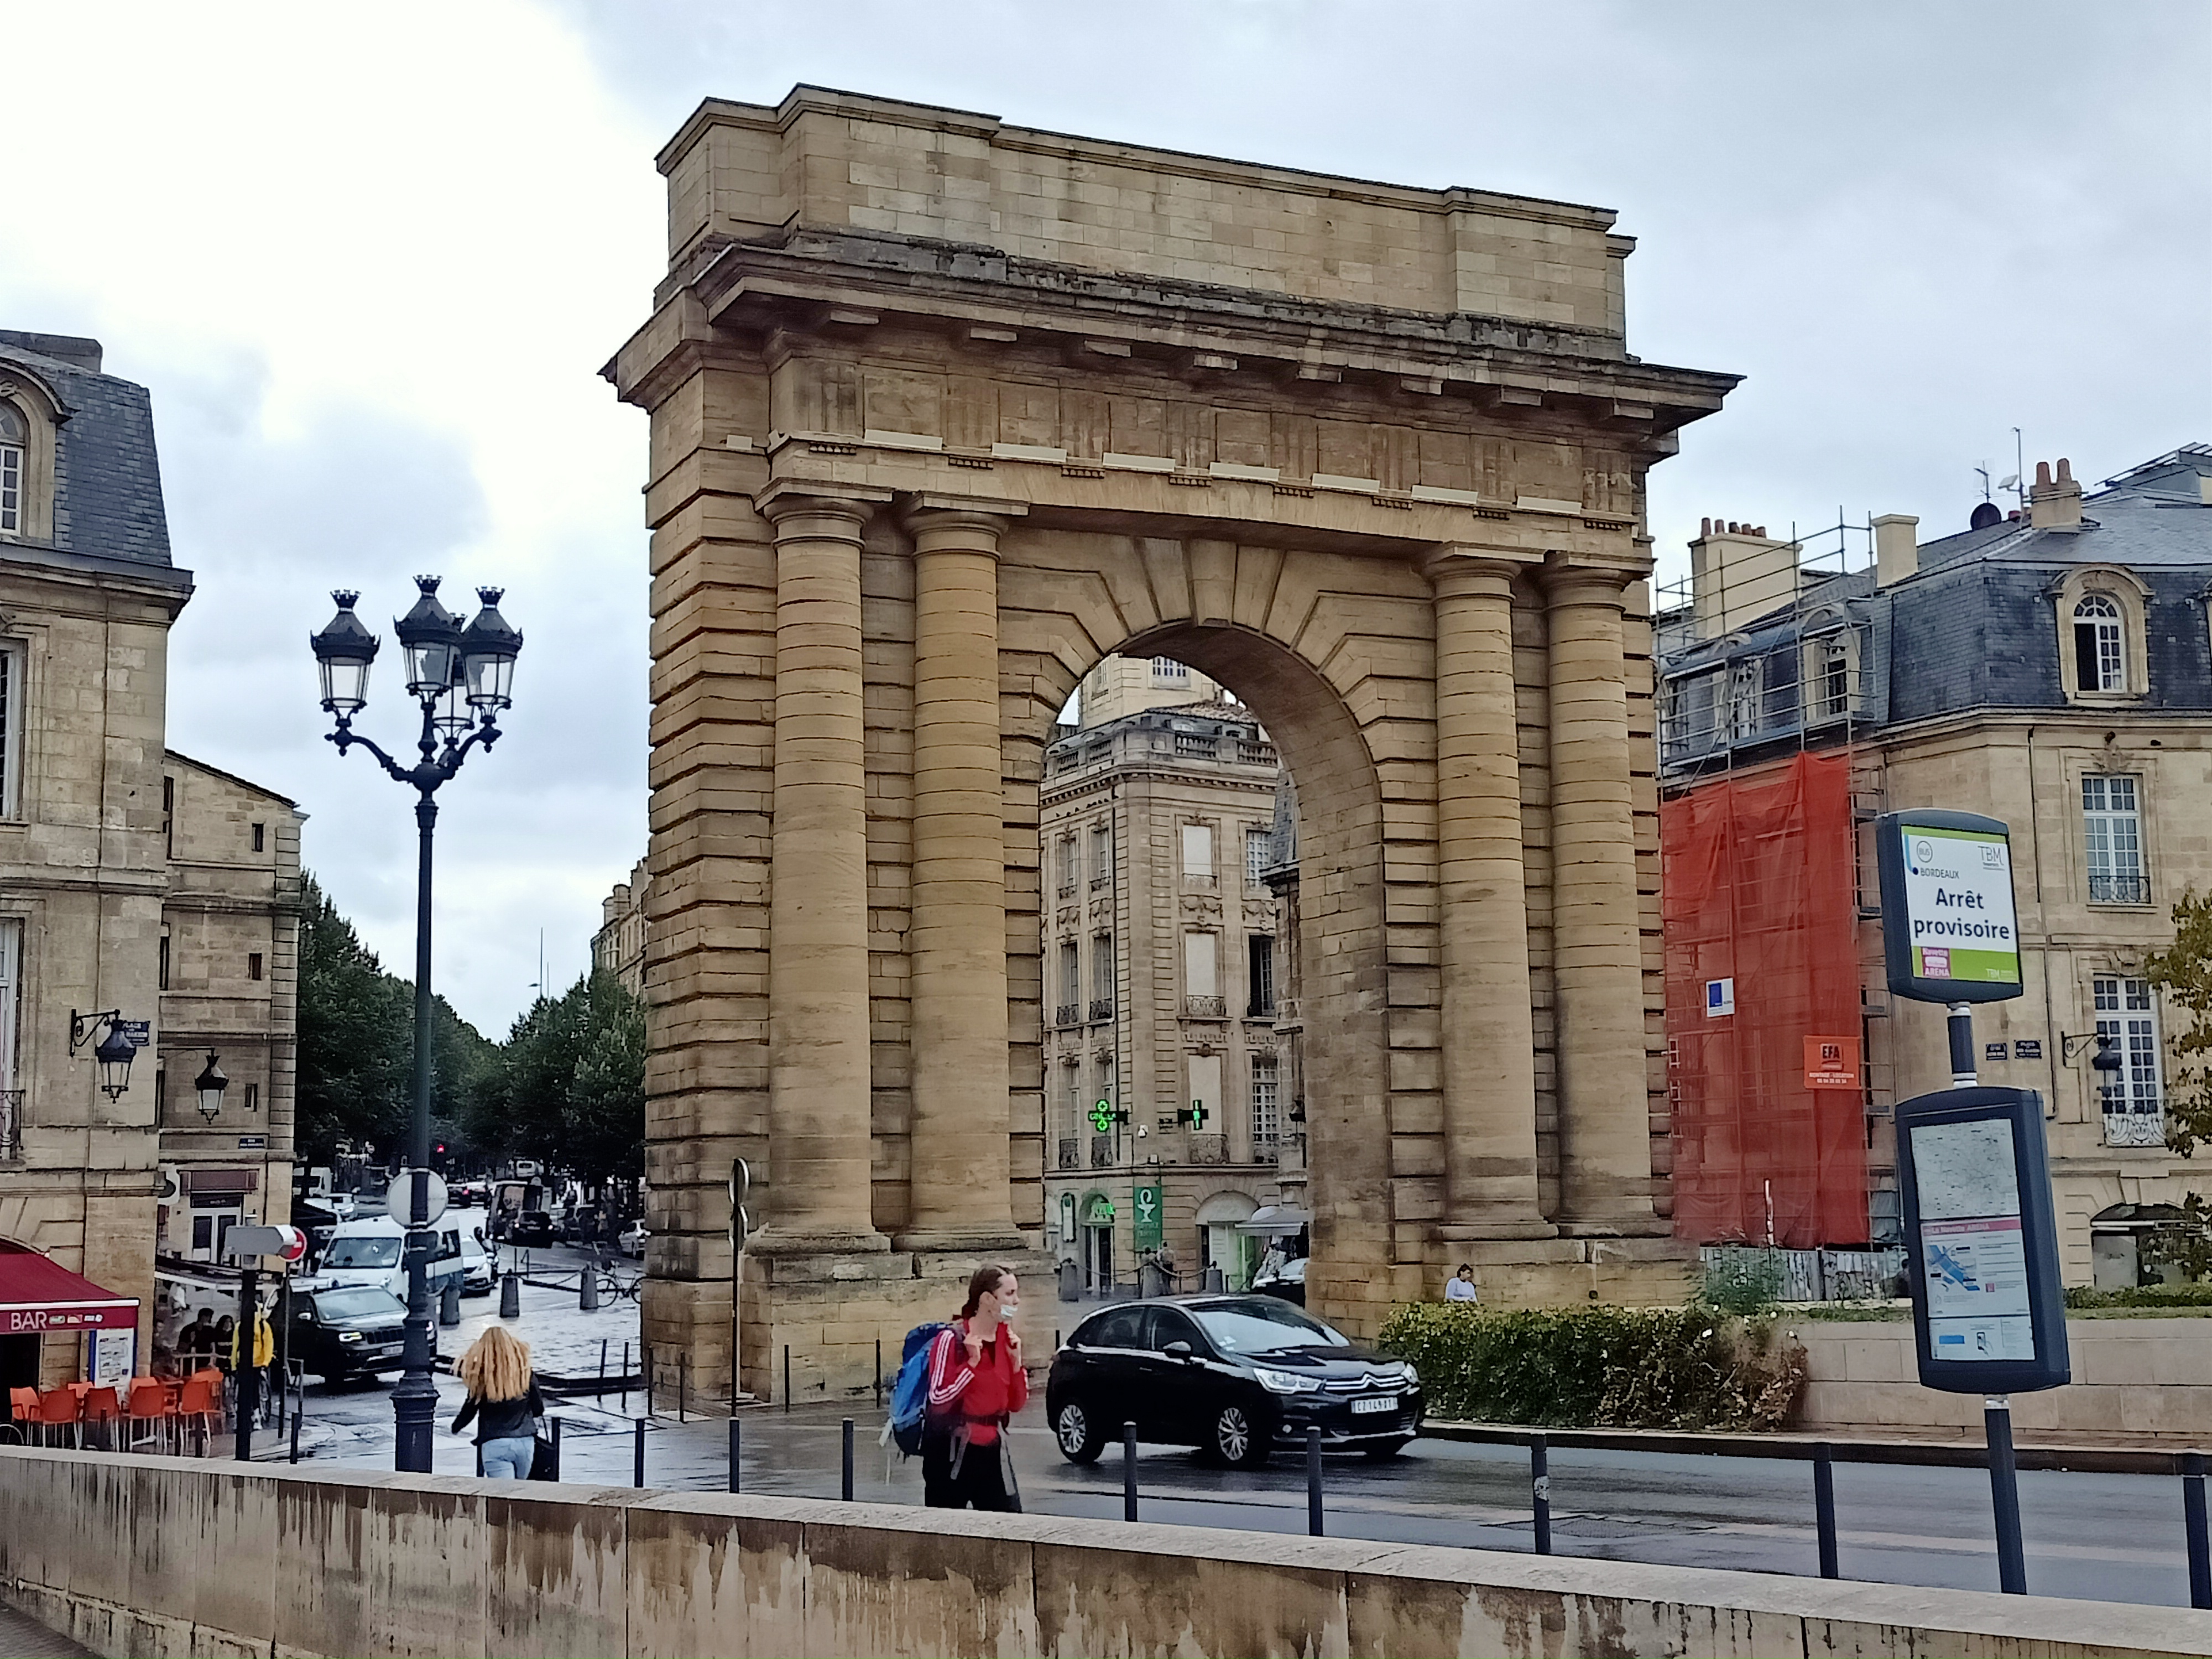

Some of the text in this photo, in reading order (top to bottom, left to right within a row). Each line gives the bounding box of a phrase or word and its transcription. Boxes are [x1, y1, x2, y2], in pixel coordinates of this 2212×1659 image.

[1918, 848, 1931, 856] BUS
[1978, 846, 2004, 866] TBM
[1921, 867, 1960, 879] BORDEAUX
[1936, 888, 1984, 909] Arrêt
[1914, 918, 2010, 940] provisoire
[1924, 968, 1950, 977] ARENA
[1823, 1045, 1840, 1059] EFA
[11, 1311, 47, 1331] BAR
